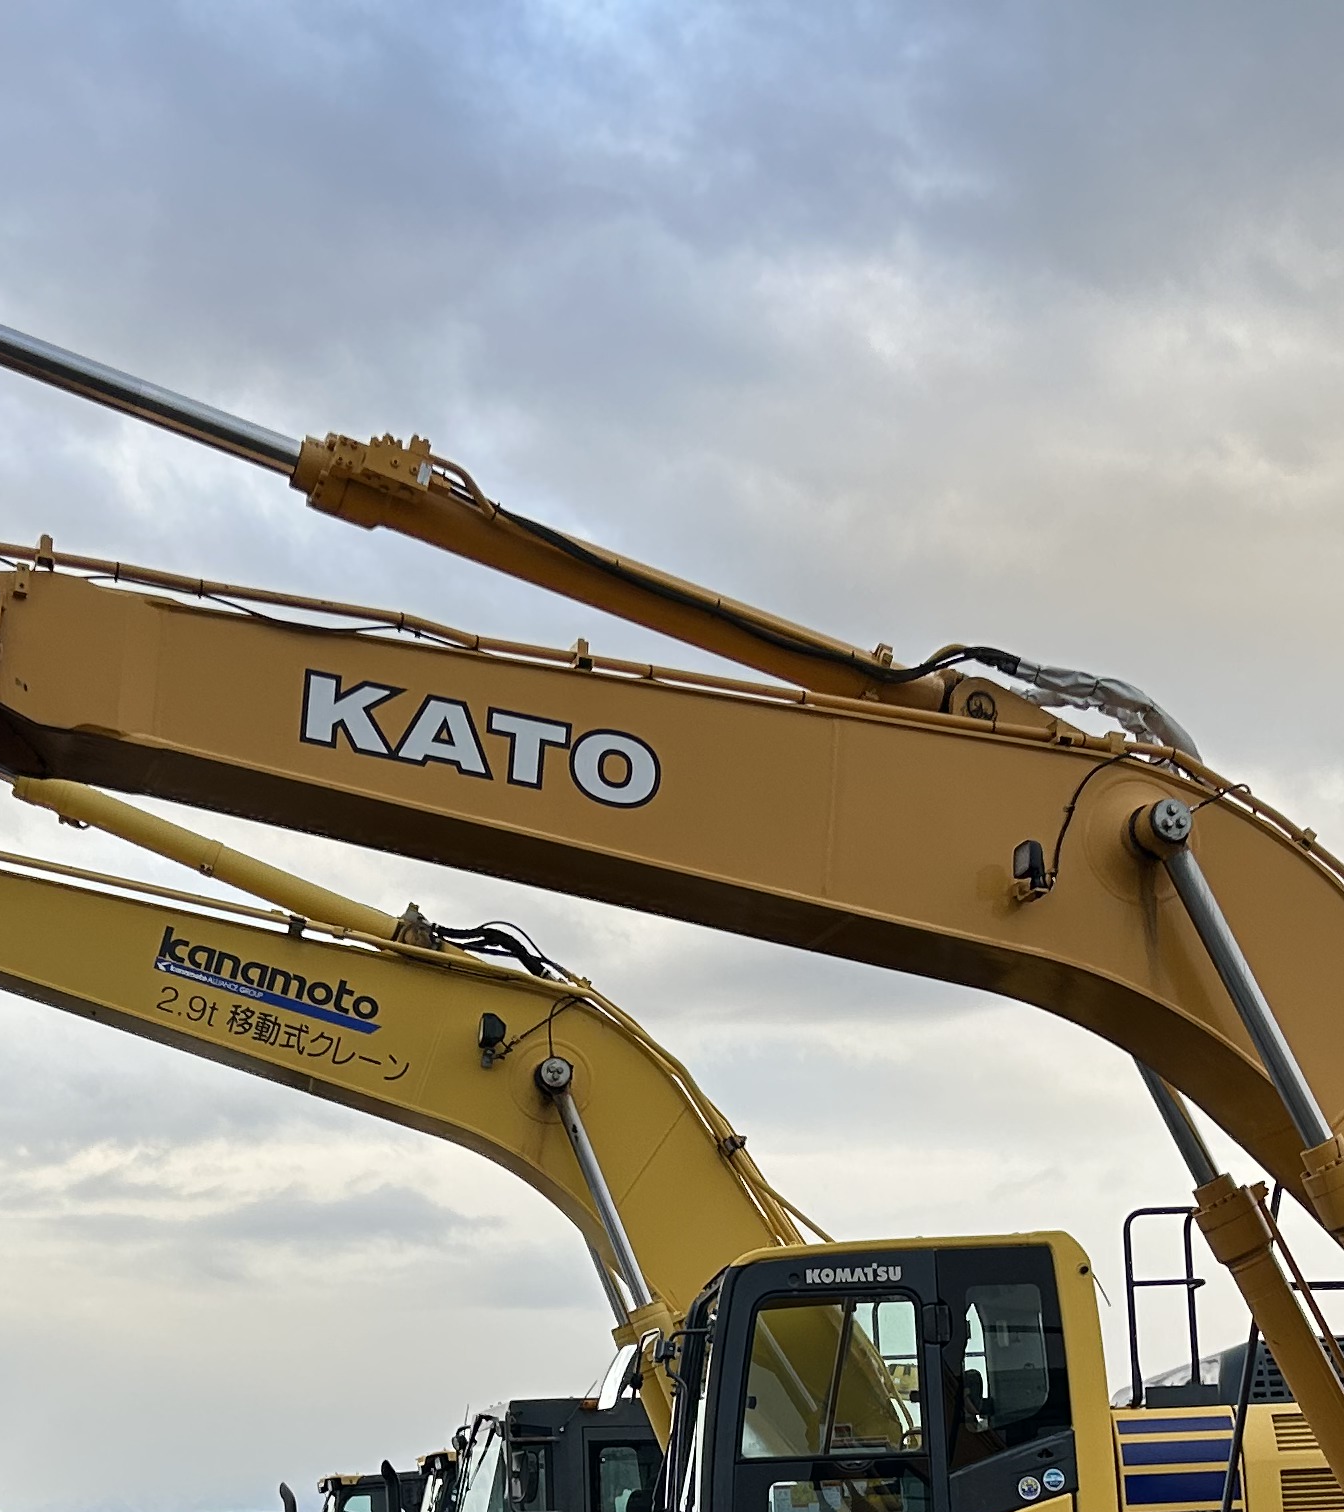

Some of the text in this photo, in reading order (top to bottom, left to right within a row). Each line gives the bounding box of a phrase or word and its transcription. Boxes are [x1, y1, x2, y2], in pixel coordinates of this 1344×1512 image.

[299, 668, 661, 809] KATO
[157, 926, 379, 1019] kanamoto
[156, 986, 410, 1080] 2.9t 移動式クレーン
[805, 1263, 902, 1284] KOMATSU
